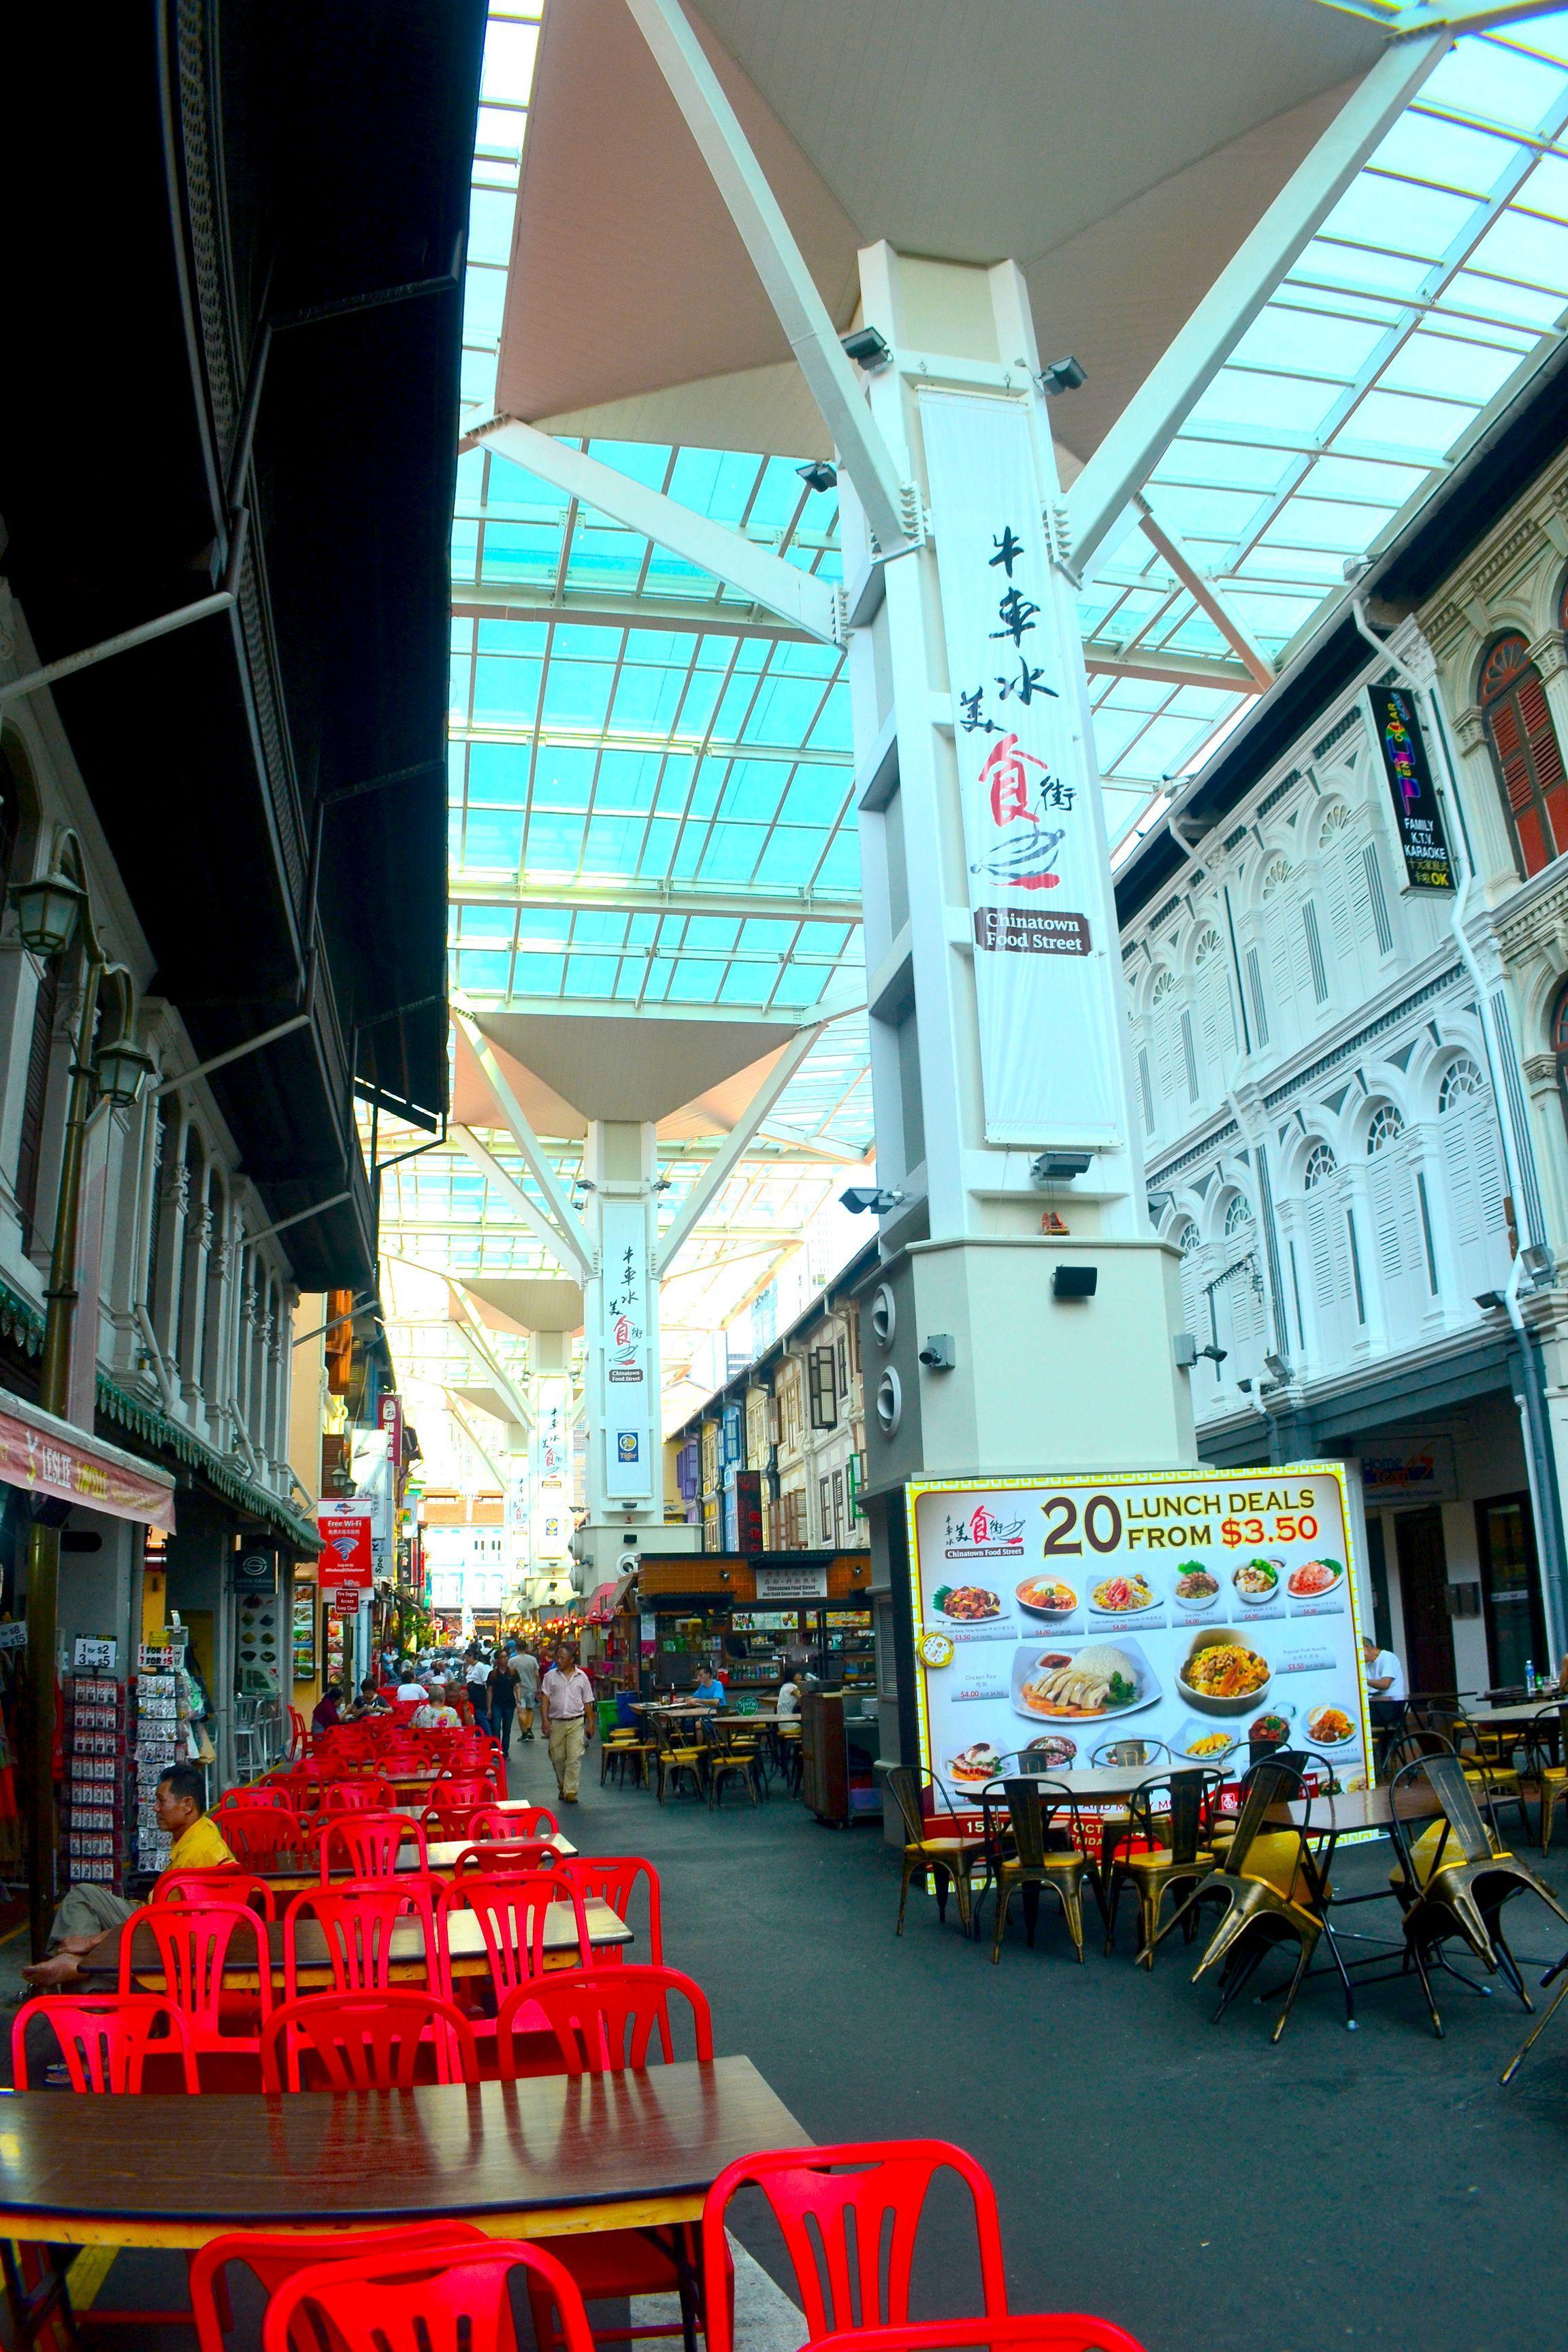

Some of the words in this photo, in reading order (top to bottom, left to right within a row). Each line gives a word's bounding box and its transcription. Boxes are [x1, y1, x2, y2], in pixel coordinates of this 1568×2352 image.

[1404, 818, 1433, 832] FAMILY
[1404, 845, 1447, 860] KARAOKE
[985, 912, 1080, 933] Chinatown
[986, 931, 1029, 949] Food
[1032, 934, 1083, 951] Street
[619, 1452, 637, 1461] Tiger
[43, 1446, 71, 1488] LESLIE
[1363, 1457, 1403, 1470] Home
[1126, 1495, 1222, 1519] LUNCH
[1228, 1489, 1315, 1514] DEALS
[1041, 1494, 1122, 1558] 20
[1128, 1525, 1211, 1550] FROM
[1221, 1515, 1318, 1548] $3.50
[947, 1549, 984, 1558] Chinatown
[984, 1548, 1002, 1556] Food
[1002, 1547, 1022, 1556] Street
[10, 1625, 20, 1635] $8
[10, 1633, 26, 1645] $15
[82, 1644, 86, 1652] 1
[97, 1644, 109, 1654] $2
[141, 1646, 144, 1654] 1
[79, 1654, 86, 1665] 3
[97, 1655, 110, 1667] $5
[146, 1656, 162, 1665] FOR
[163, 1656, 173, 1665] $5
[960, 1690, 979, 1699] $4.00
[966, 1821, 985, 1833] 15
